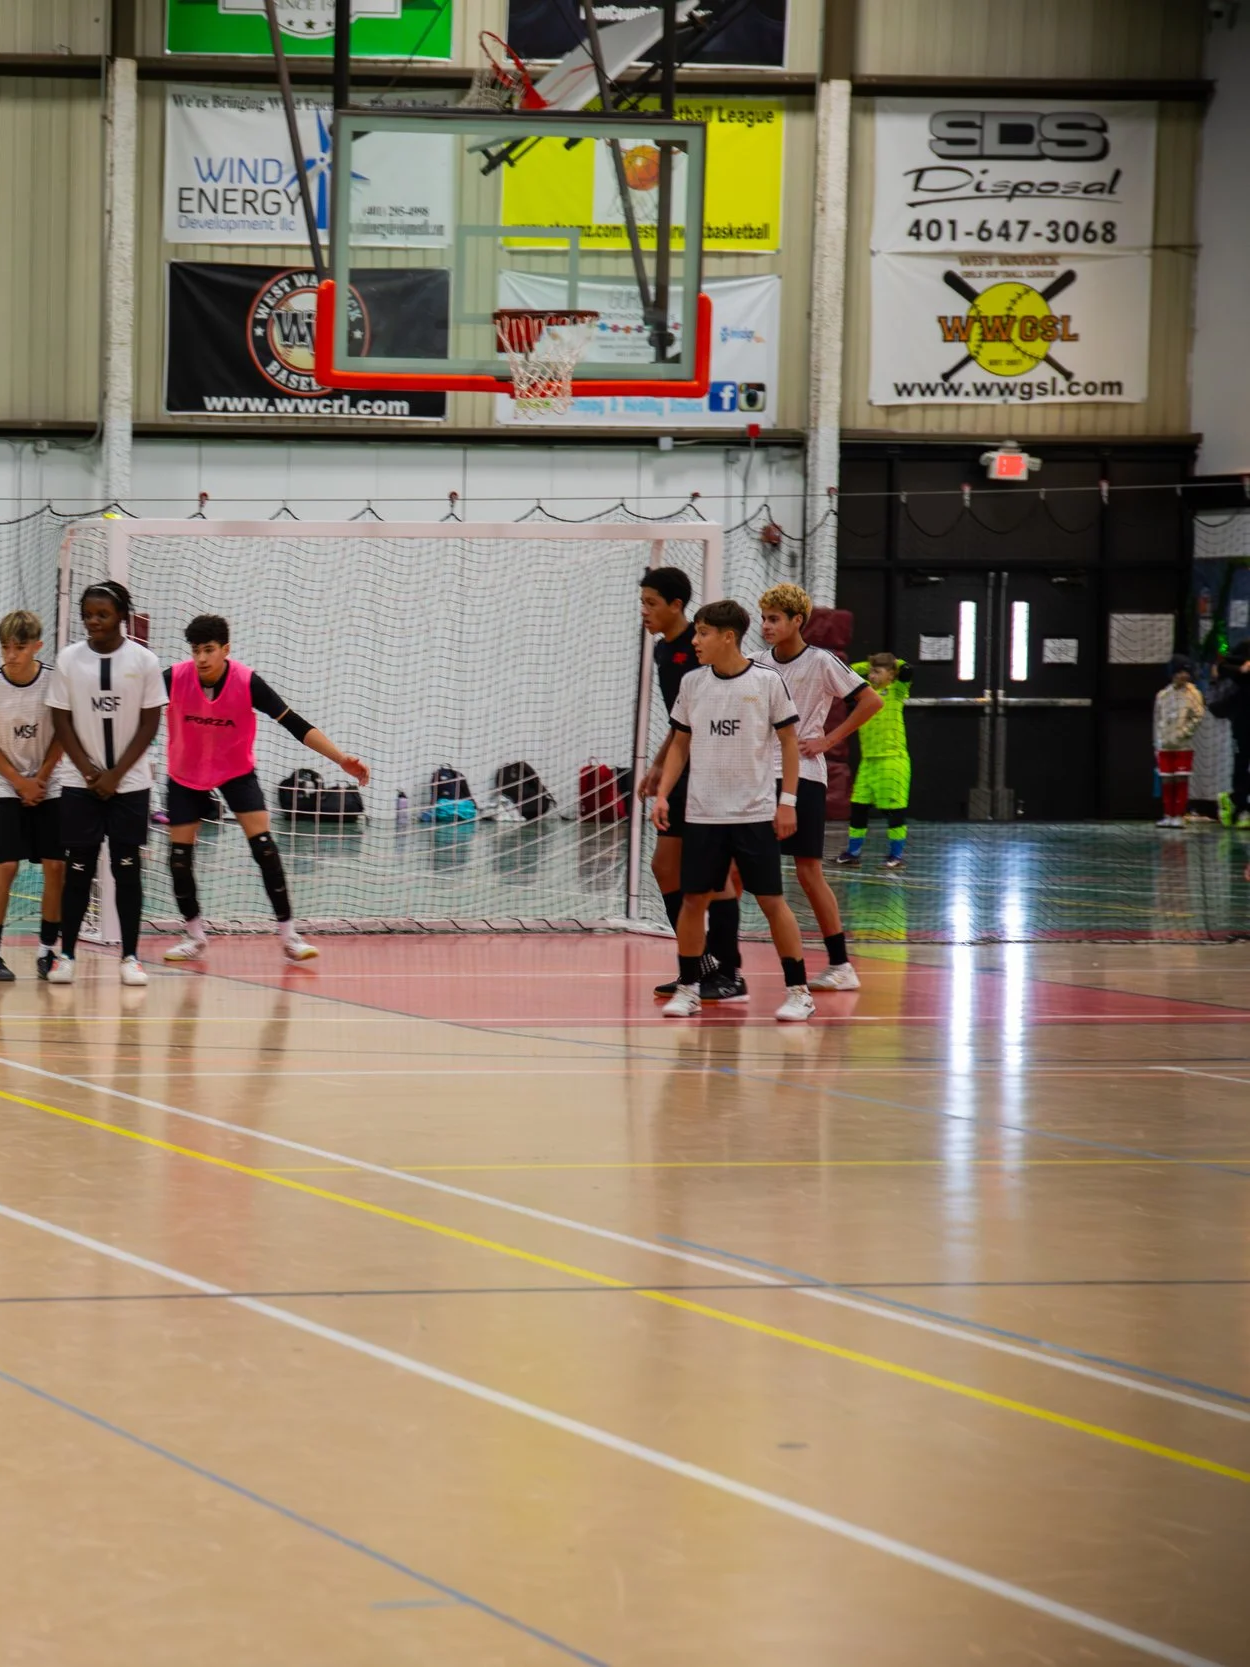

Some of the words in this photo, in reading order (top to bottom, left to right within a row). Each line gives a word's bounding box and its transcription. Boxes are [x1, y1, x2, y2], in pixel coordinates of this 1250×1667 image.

[718, 105, 775, 127] League
[928, 110, 1110, 162] SDS
[193, 157, 282, 184] WIND
[903, 165, 1122, 202] Disposal
[178, 187, 303, 215] ENERGY
[178, 215, 275, 235] Development
[907, 218, 1118, 244] 401-647-3068
[958, 255, 993, 267] WEST
[254, 278, 291, 320] WEST
[938, 314, 1080, 343] WWGSL
[894, 377, 1124, 401] www.wwgsl.com
[203, 395, 410, 416] www.wwcrl.com
[91, 696, 121, 712] MSF
[13, 723, 39, 740] MSF
[184, 714, 237, 728] FORZA
[710, 719, 741, 736] MSF
